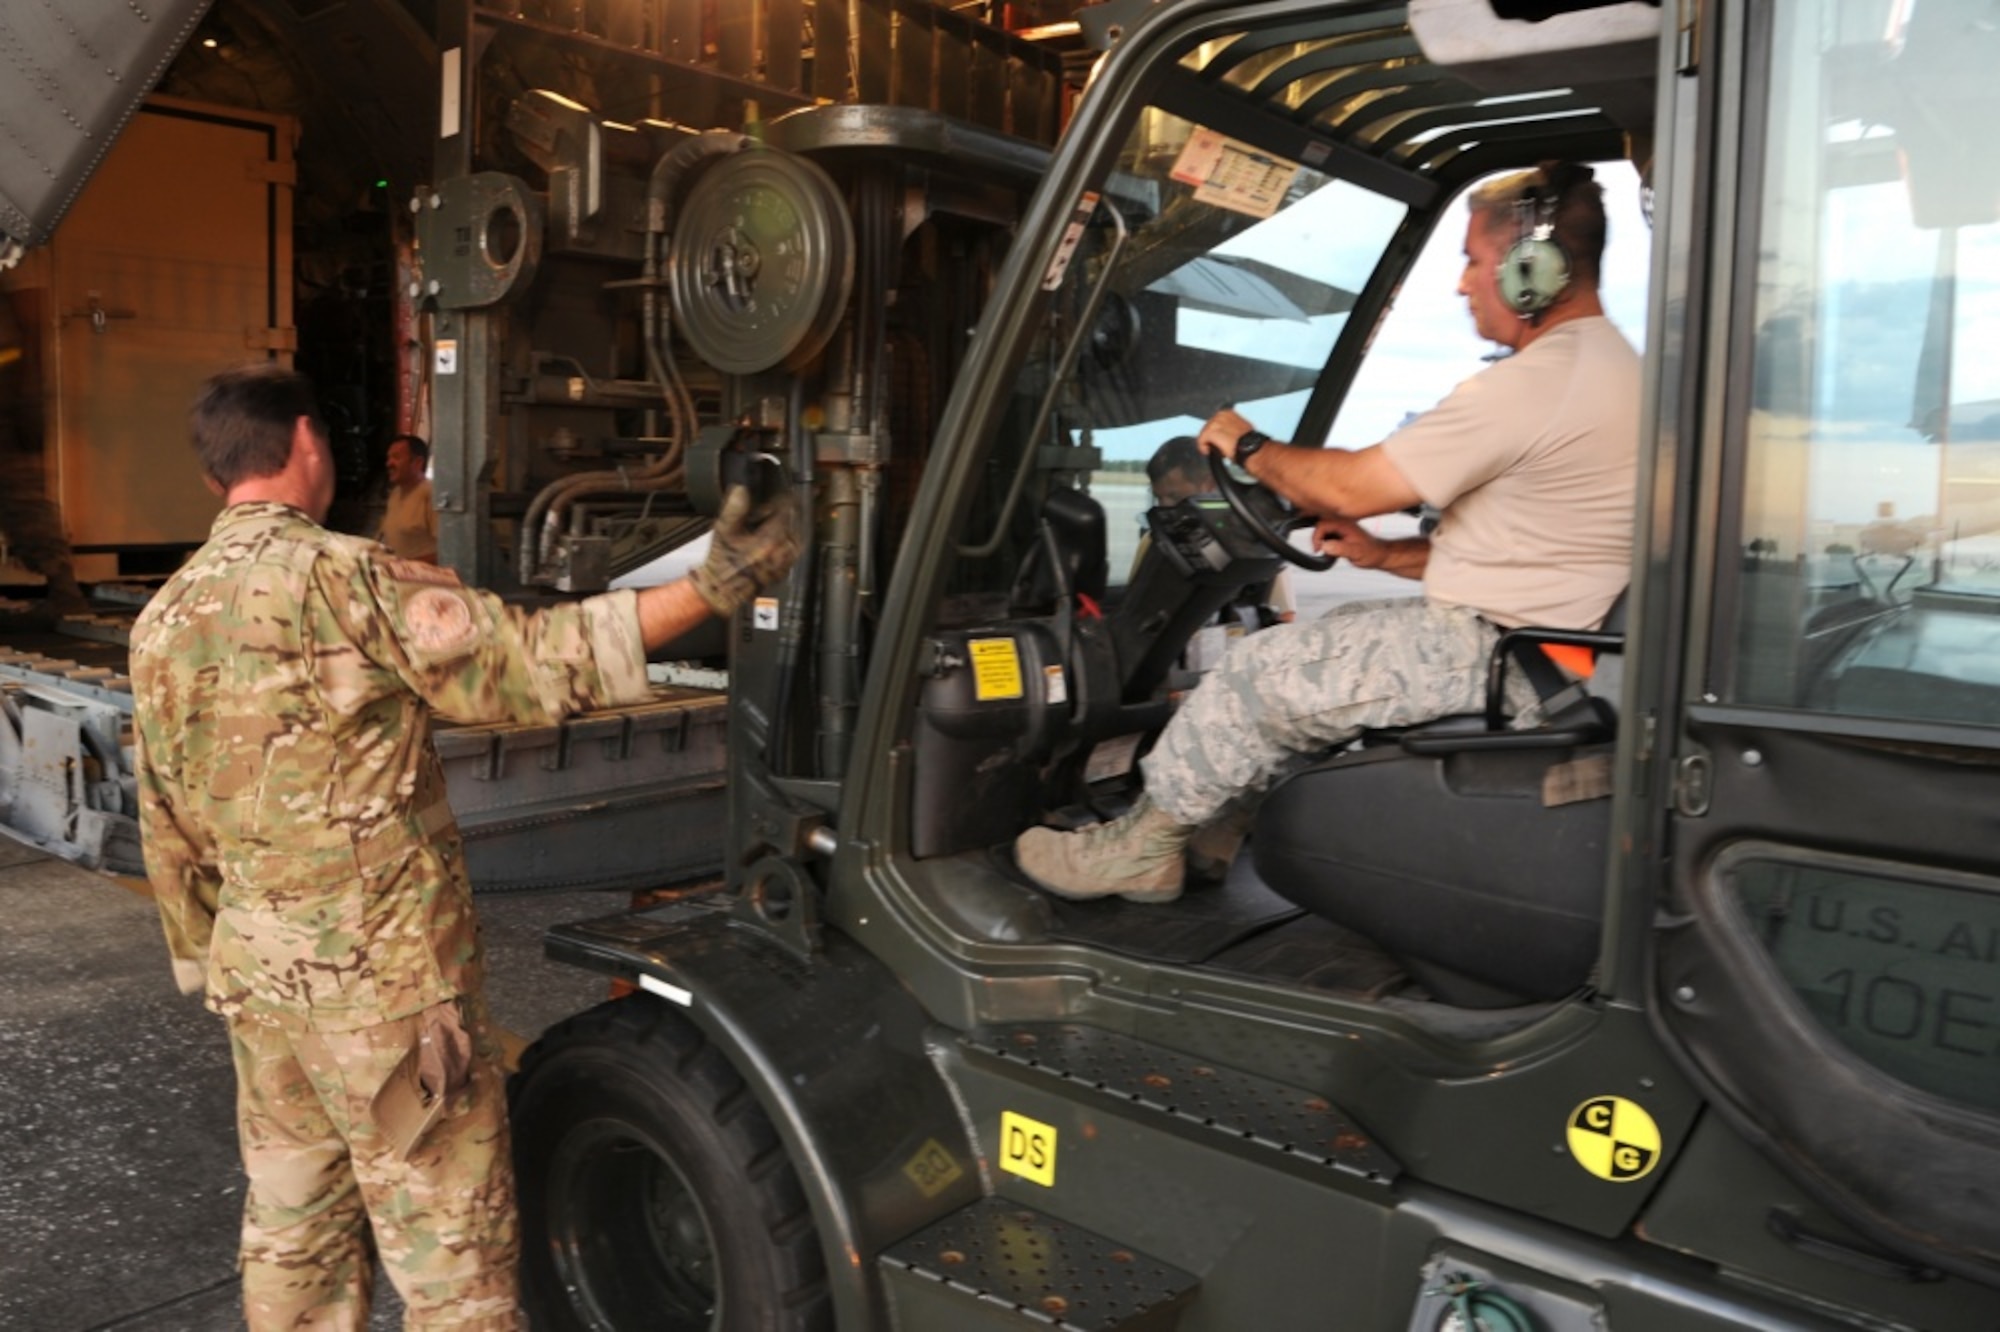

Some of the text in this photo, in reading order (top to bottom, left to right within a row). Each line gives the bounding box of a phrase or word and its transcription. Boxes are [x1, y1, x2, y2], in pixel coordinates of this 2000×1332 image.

[1821, 967, 2000, 1058] 10E
[1584, 1104, 1611, 1129] C
[1009, 1125, 1047, 1170] DS
[1614, 1146, 1641, 1171] G
